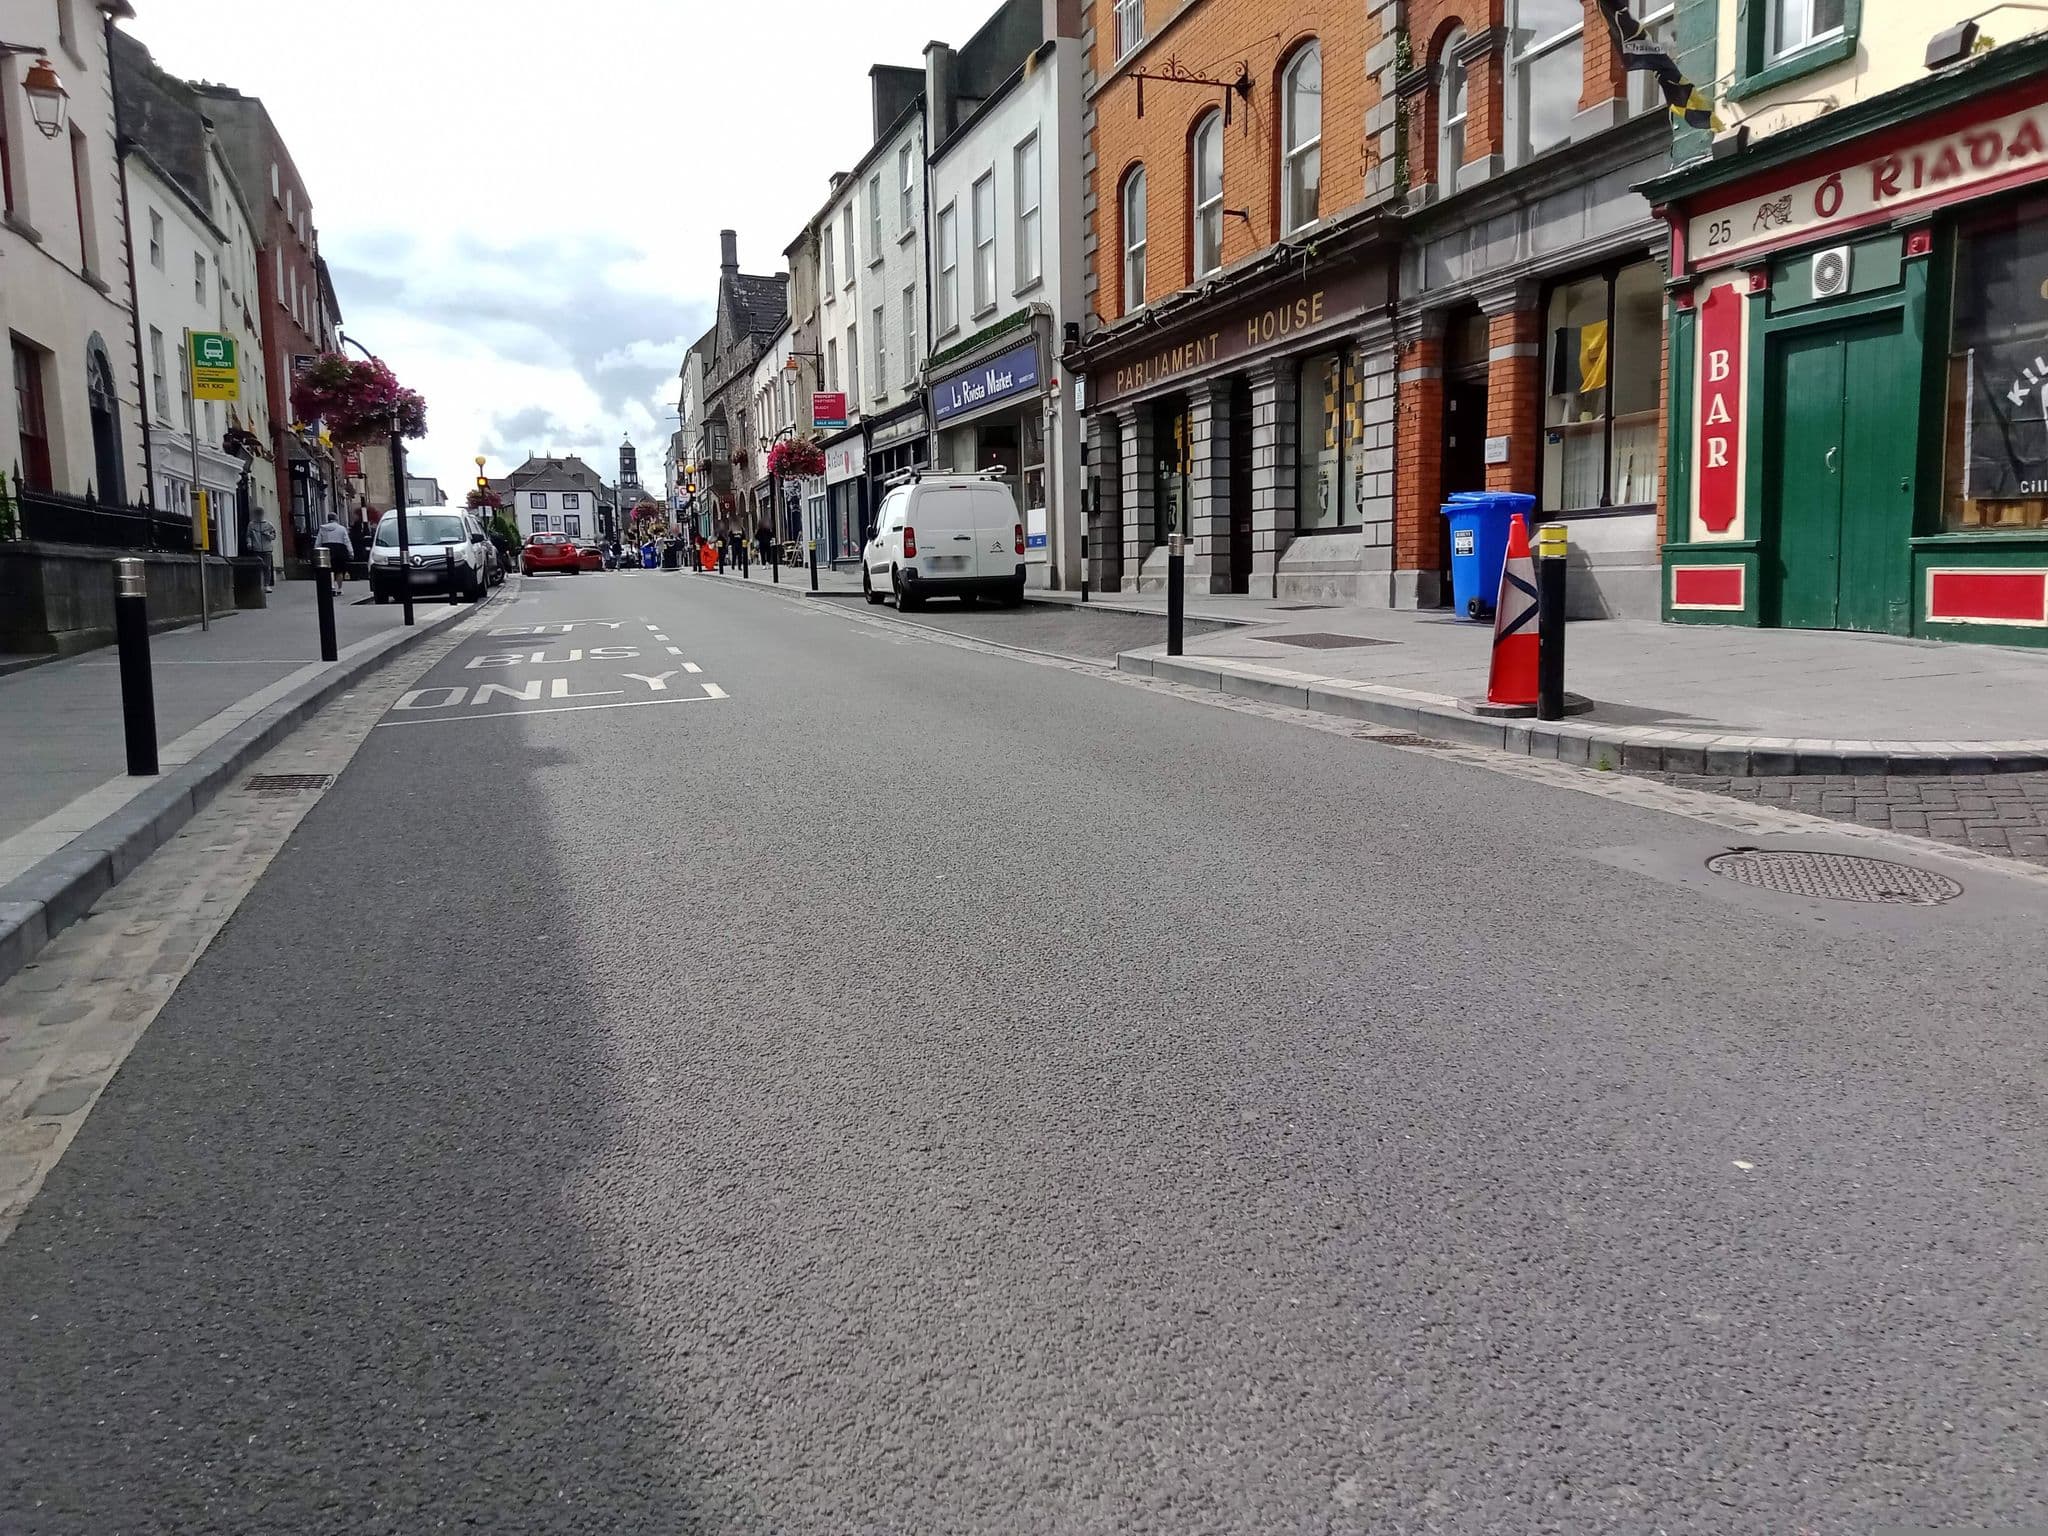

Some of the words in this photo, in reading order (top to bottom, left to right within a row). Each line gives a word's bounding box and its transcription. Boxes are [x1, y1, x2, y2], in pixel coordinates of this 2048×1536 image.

[1708, 219, 1732, 247] 25
[1871, 117, 2045, 202] RIADA
[1117, 333, 1219, 392] PARLIAMENT
[1247, 291, 1325, 345] HOUSE
[951, 386, 962, 409] La
[962, 381, 985, 405] Rivista
[985, 368, 1013, 395] Market
[1705, 349, 1732, 468] BAR
[487, 621, 627, 636] CITY
[465, 646, 641, 669] BUS
[391, 670, 679, 710] ONLY
